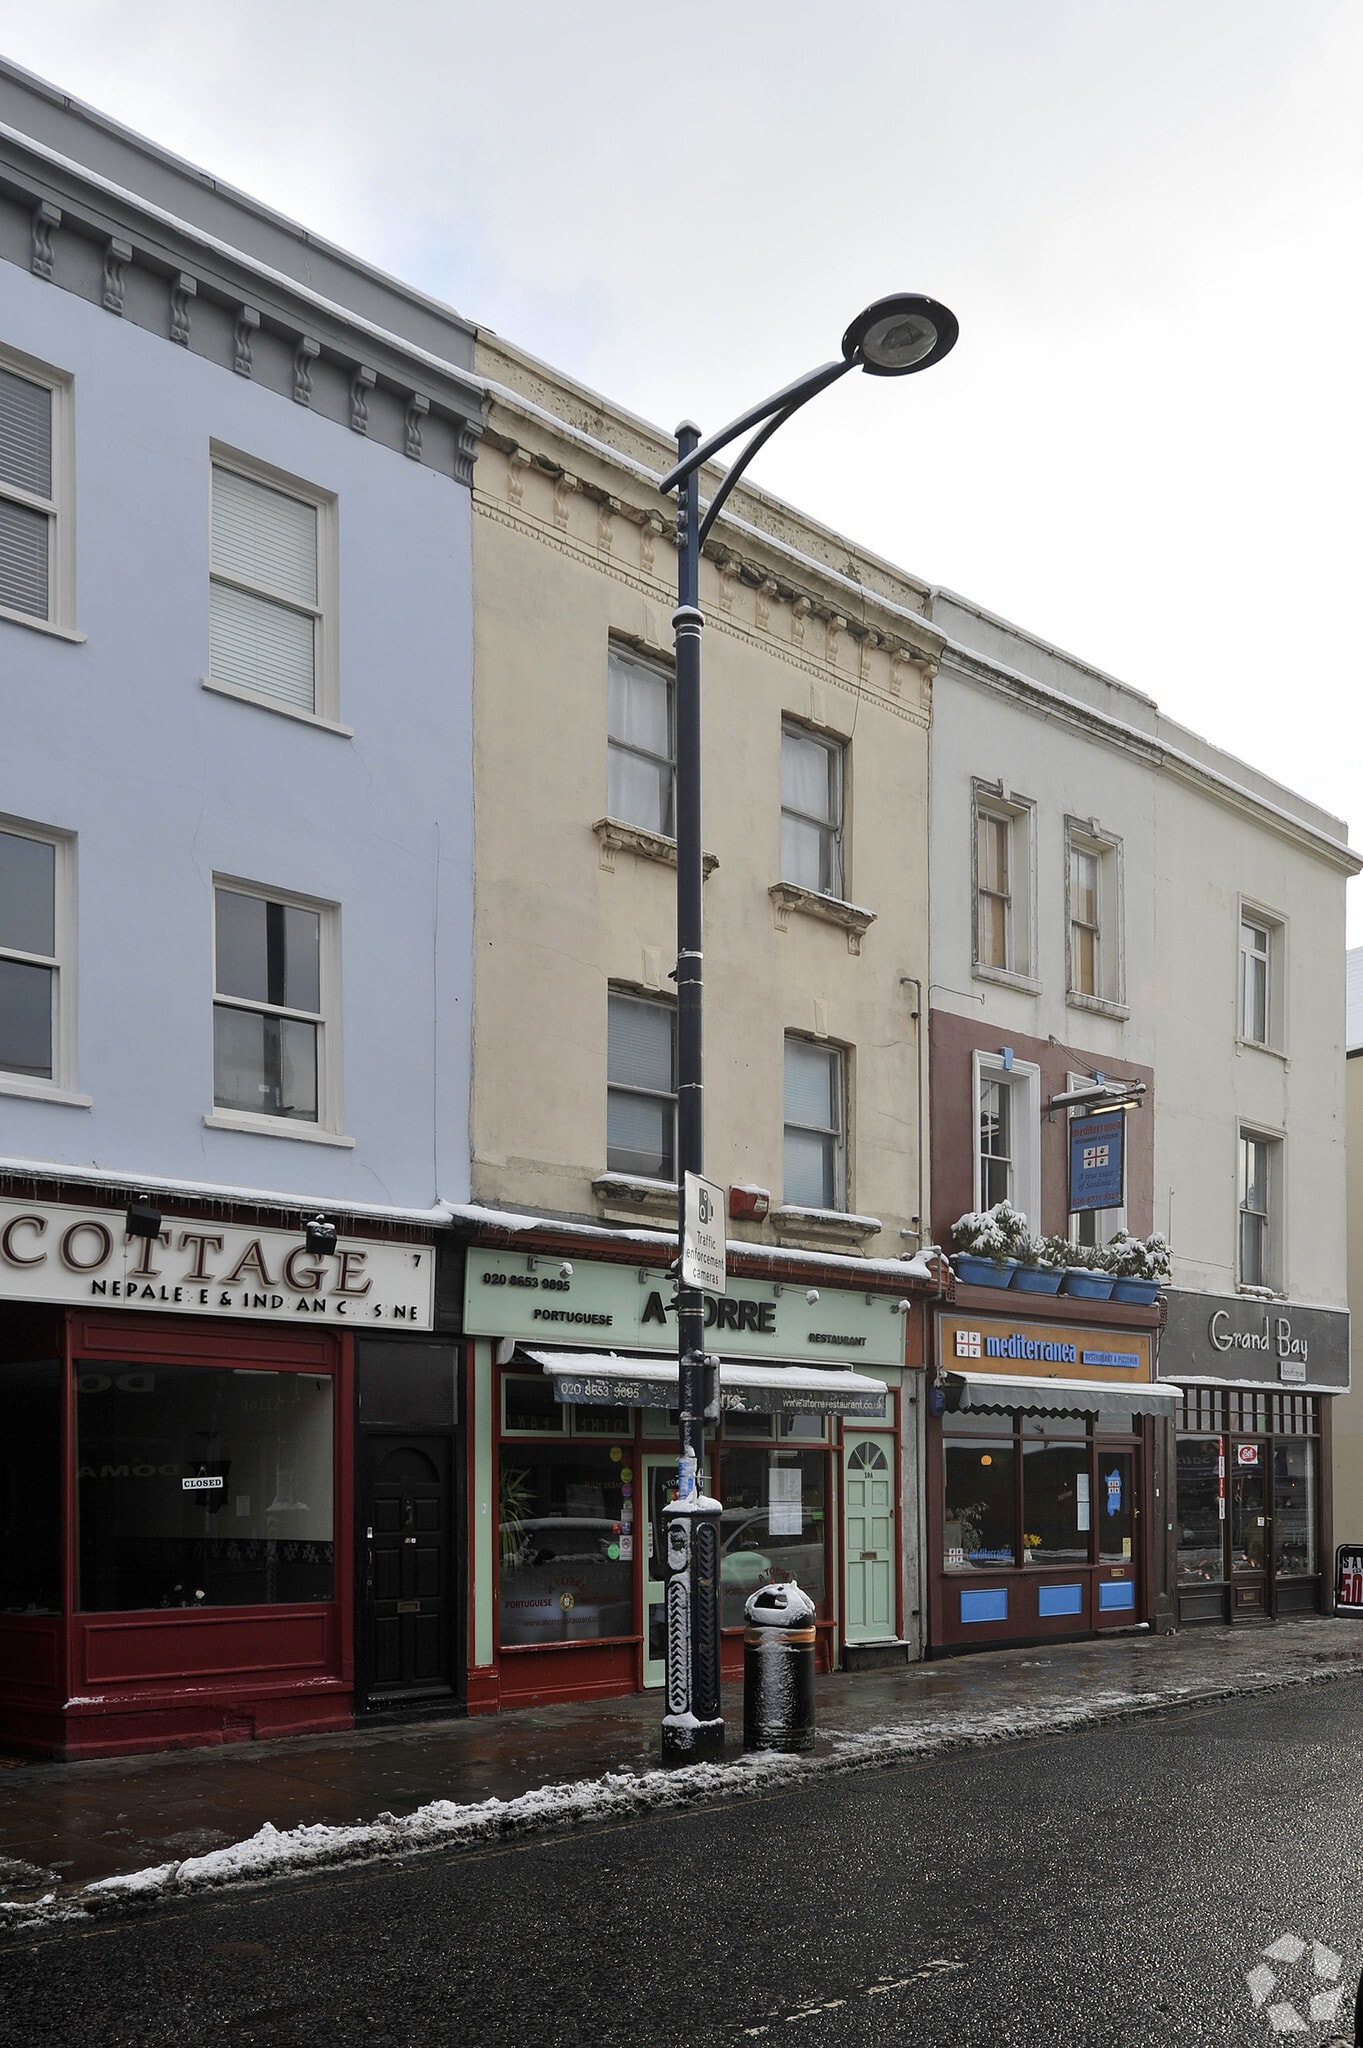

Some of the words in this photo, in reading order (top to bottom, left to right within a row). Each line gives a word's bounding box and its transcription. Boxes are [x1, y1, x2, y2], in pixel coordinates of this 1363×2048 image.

[697, 1231, 716, 1249] Traffic
[1, 1213, 373, 1297] COTTAGE
[686, 1247, 724, 1270] enforcement
[483, 1273, 506, 1285] 020
[509, 1275, 538, 1288] 8653
[693, 1267, 719, 1285] cameras
[92, 1279, 208, 1305] NEPALEE
[219, 1291, 232, 1305] &
[244, 1292, 326, 1313] INDAN
[642, 1291, 667, 1324] A
[703, 1296, 776, 1333] ORRE
[534, 1309, 613, 1326] PORTUGUESE
[809, 1333, 866, 1347] RESTAURANT
[1208, 1310, 1270, 1351] Grand
[1276, 1317, 1308, 1361] Bay
[986, 1333, 1076, 1363] mediterranea
[1118, 1355, 1138, 1365] PIZZERIA
[561, 1383, 581, 1395] 020
[584, 1384, 609, 1397] 8653
[183, 1477, 222, 1489] CLOSED
[968, 1548, 1012, 1561] mediterranea
[548, 1584, 555, 1594] A
[505, 1598, 552, 1609] PORTUGUESE
